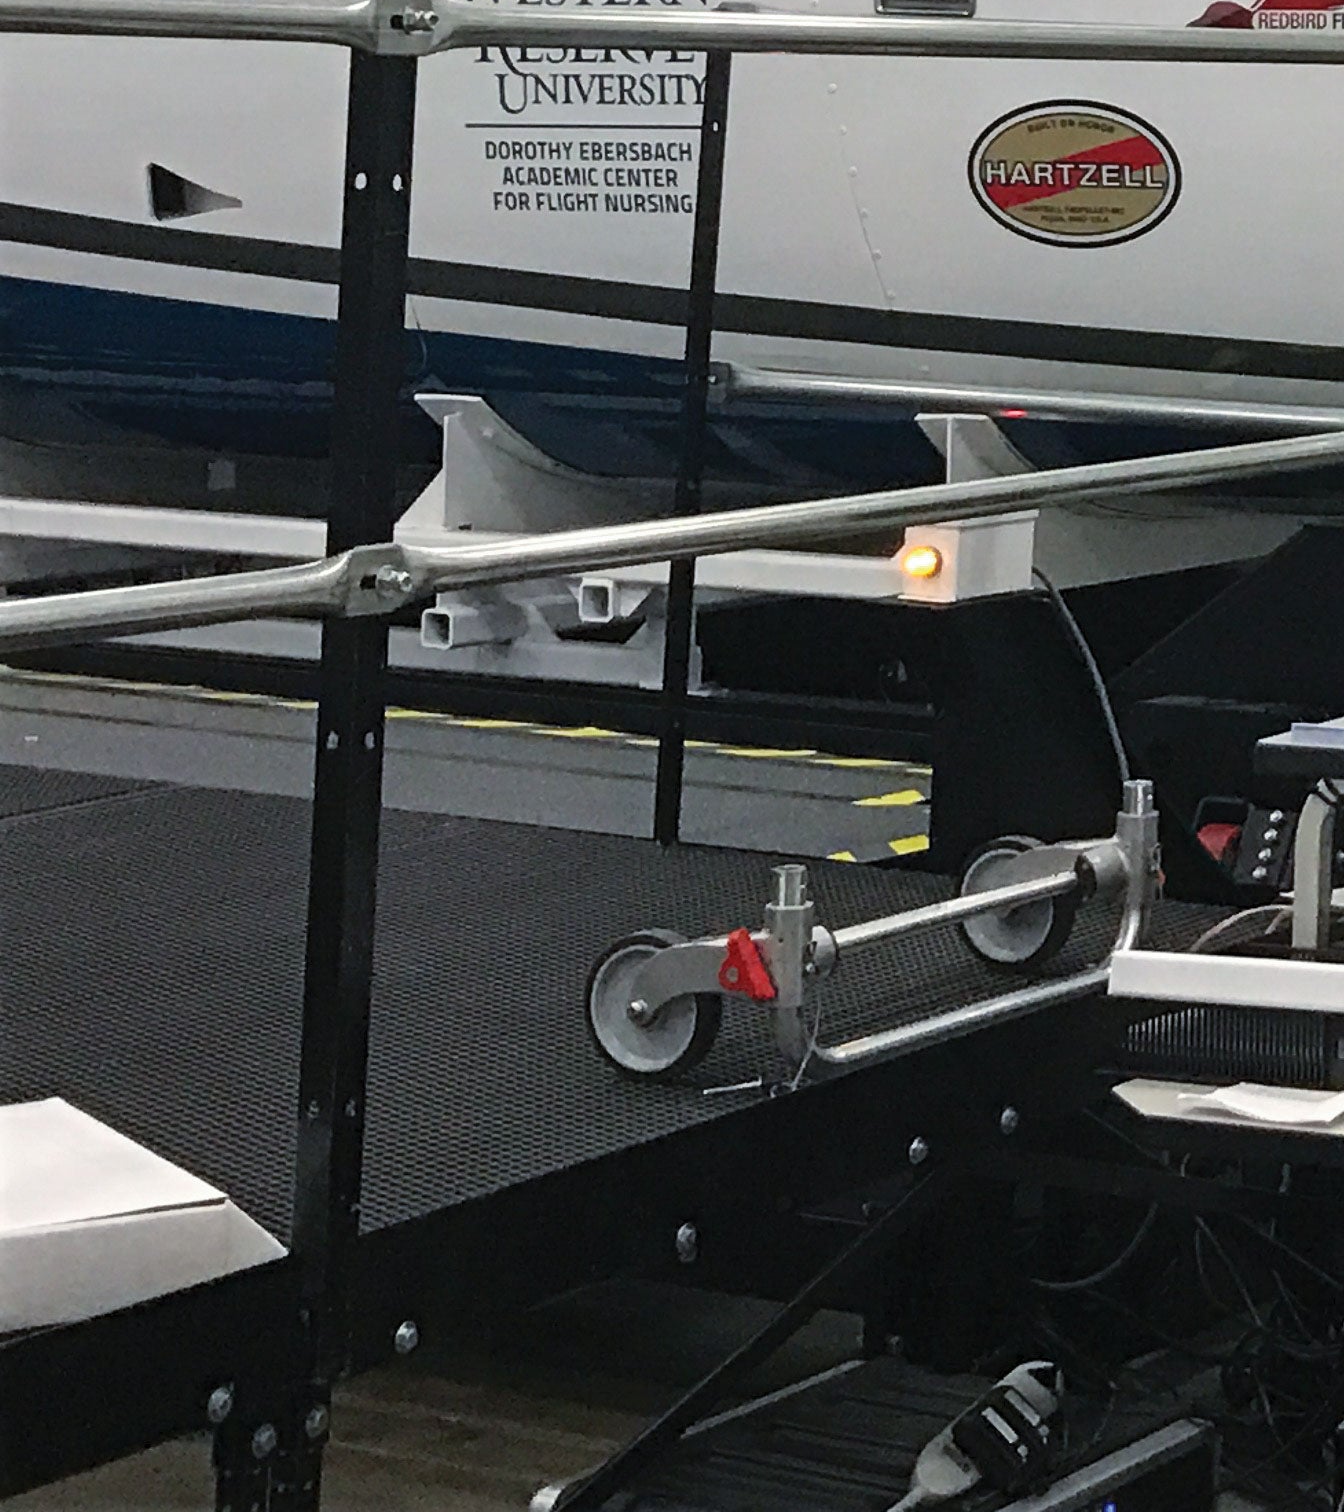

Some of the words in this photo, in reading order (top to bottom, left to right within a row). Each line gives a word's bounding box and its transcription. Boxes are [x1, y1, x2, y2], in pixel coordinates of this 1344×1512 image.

[1258, 12, 1327, 30] REDBIRD
[494, 73, 706, 114] UNIVERSITY
[484, 140, 574, 160] DOROTHY
[579, 141, 693, 162] EBERSBACH
[502, 166, 599, 186] ACADEMIC
[603, 167, 679, 188] CENTER
[983, 160, 1165, 189] HARTZELL
[493, 191, 531, 211] FOR
[535, 192, 599, 212] FLIGHT
[604, 193, 694, 214] NURSING
